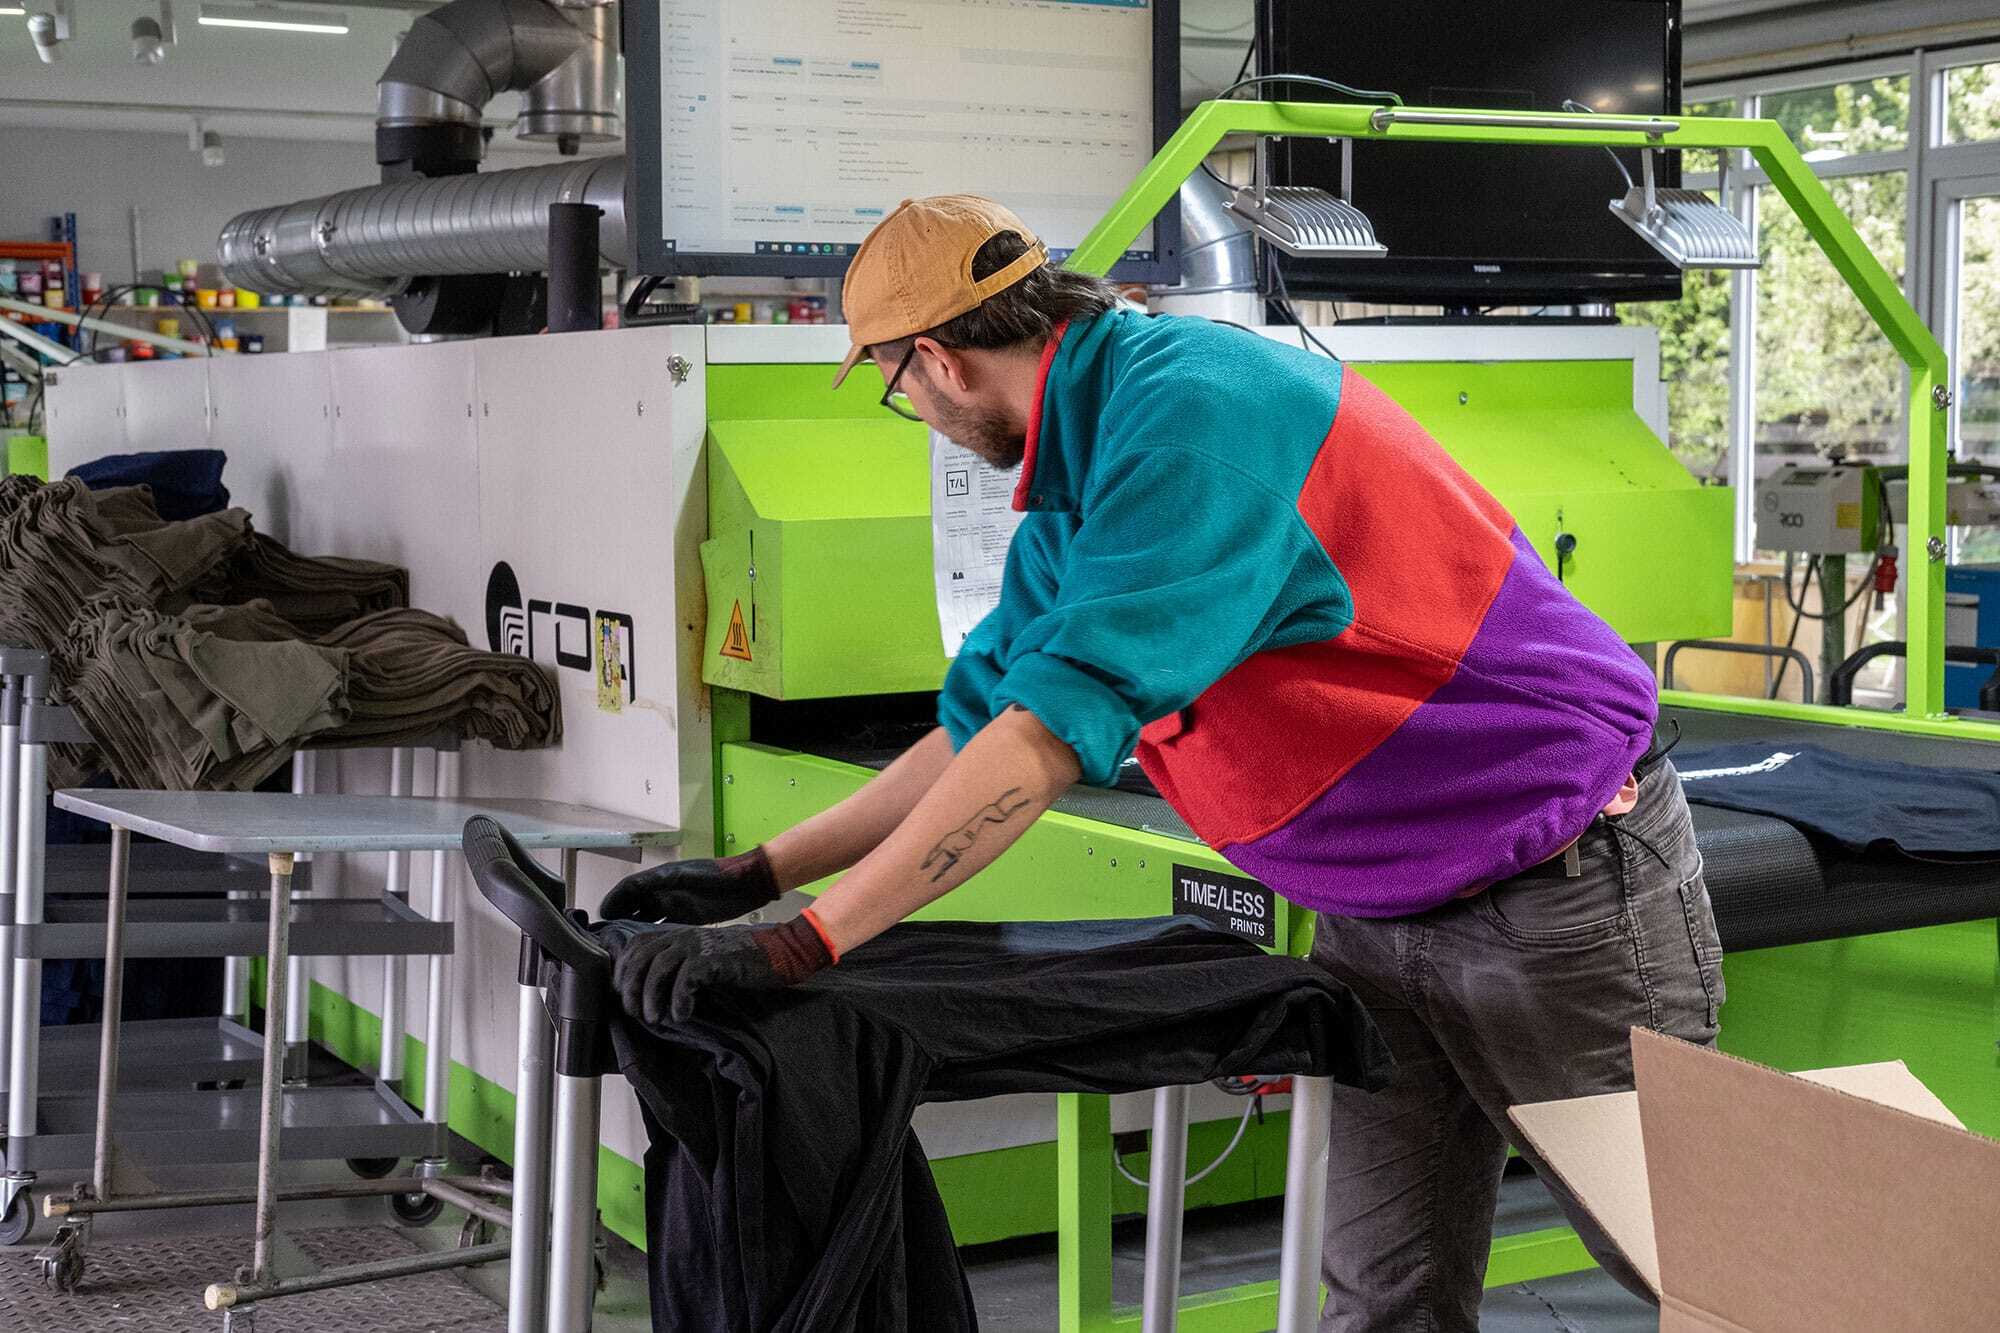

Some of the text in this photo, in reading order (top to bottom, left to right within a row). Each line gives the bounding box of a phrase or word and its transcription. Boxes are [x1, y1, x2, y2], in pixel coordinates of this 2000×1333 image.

[949, 478, 966, 489] T/L
[1180, 878, 1265, 919] TIME/LESS
[1229, 917, 1265, 938] PRINTS
